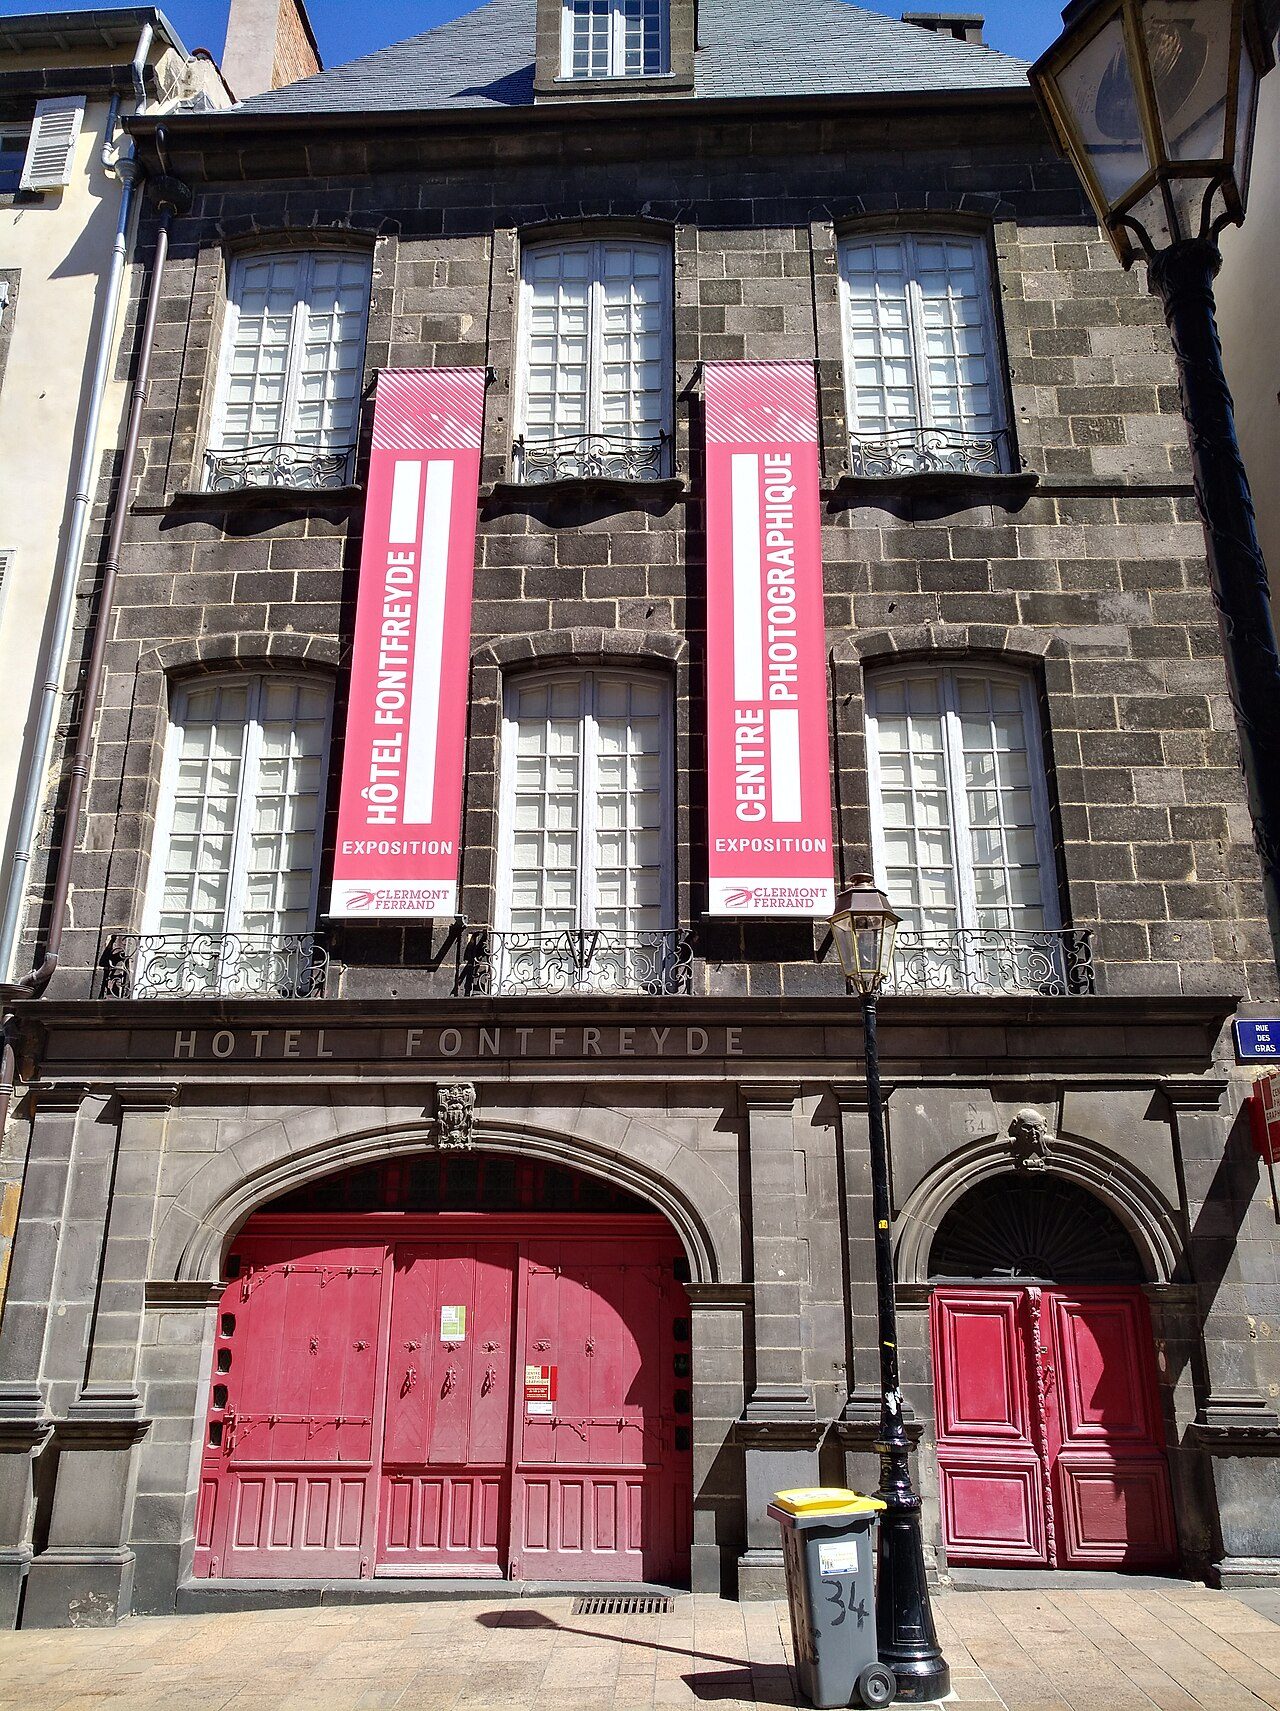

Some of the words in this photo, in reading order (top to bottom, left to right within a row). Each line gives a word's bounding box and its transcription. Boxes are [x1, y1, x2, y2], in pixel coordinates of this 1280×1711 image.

[763, 452, 799, 701] PHOTOGRAPHIQUE
[374, 551, 416, 725] FONTFREYDE
[734, 708, 767, 823] CENTRE
[360, 732, 403, 825] HÔTEL
[341, 840, 454, 856] EXPOSITION
[714, 837, 828, 853] EXPOSITION
[375, 889, 450, 901] CLERMONT
[752, 887, 828, 898] CLERMONT
[374, 900, 436, 911] FERRAND
[753, 898, 815, 909] FERRAND
[1254, 1024, 1270, 1033] RUE
[173, 1029, 333, 1058] HOTEL
[405, 1027, 744, 1056] FONTFREYDE
[1256, 1034, 1271, 1042] DES
[1254, 1044, 1276, 1053] GRAS
[964, 1118, 987, 1133] 34
[821, 1578, 870, 1631] 34
